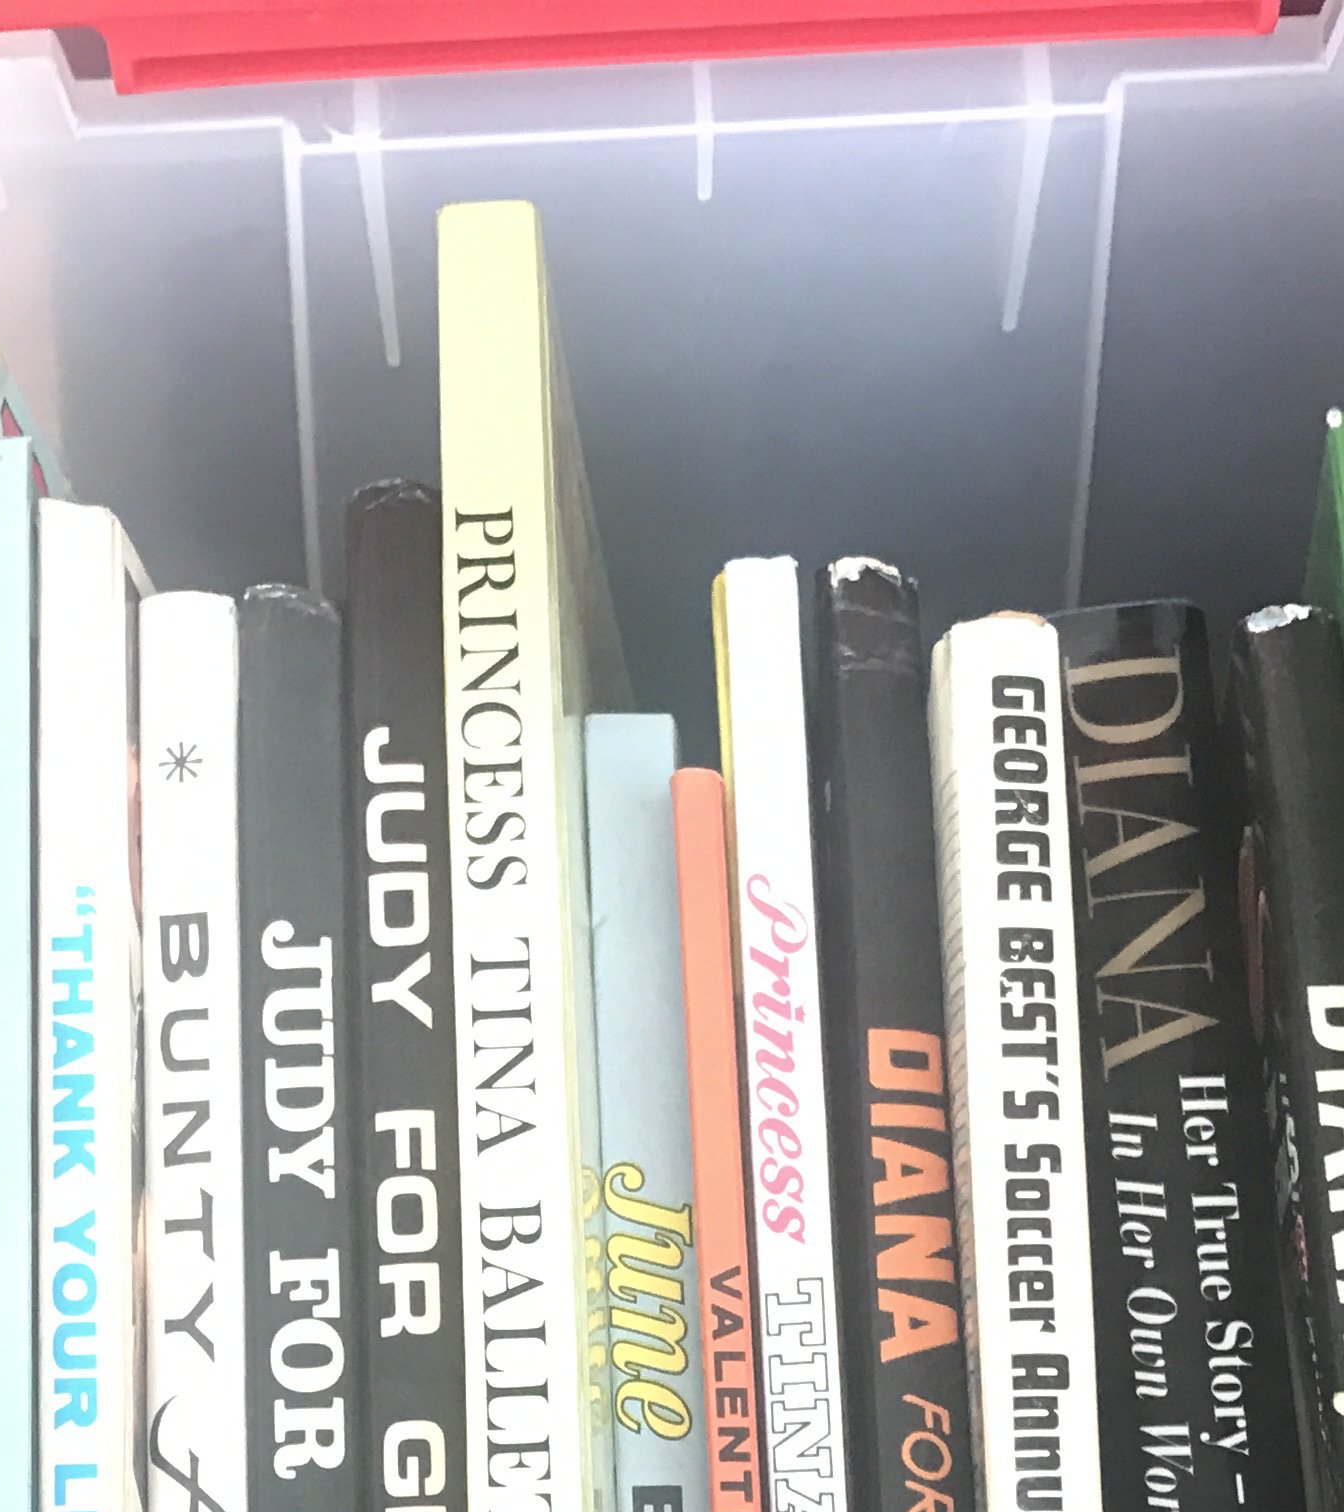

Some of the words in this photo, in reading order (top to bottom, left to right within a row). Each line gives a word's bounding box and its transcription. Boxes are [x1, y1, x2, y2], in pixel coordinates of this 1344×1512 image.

[455, 506, 528, 891] PRINCESS
[991, 673, 1053, 902] GEORGE
[363, 725, 433, 1030] JUDY
[1063, 643, 1220, 1084] DIANA
[158, 911, 216, 1363] BUNTY
[261, 919, 336, 1200] JUDY
[470, 936, 538, 1157] TINA
[747, 872, 810, 1246] Princess
[997, 926, 1061, 1121] BEST'S
[1107, 1109, 1158, 1161] In
[1179, 1073, 1228, 1170] Her
[375, 1109, 443, 1339] FOR
[602, 1161, 694, 1442] June
[867, 1027, 958, 1363] DIANA
[1003, 1141, 1063, 1334] Soccer
[1115, 1177, 1167, 1269] Her
[1192, 1181, 1240, 1302] True
[51, 1210, 98, 1430] YOUR
[269, 1248, 346, 1480] FOR
[1126, 1287, 1179, 1400] Own
[1199, 1317, 1254, 1457] Story
